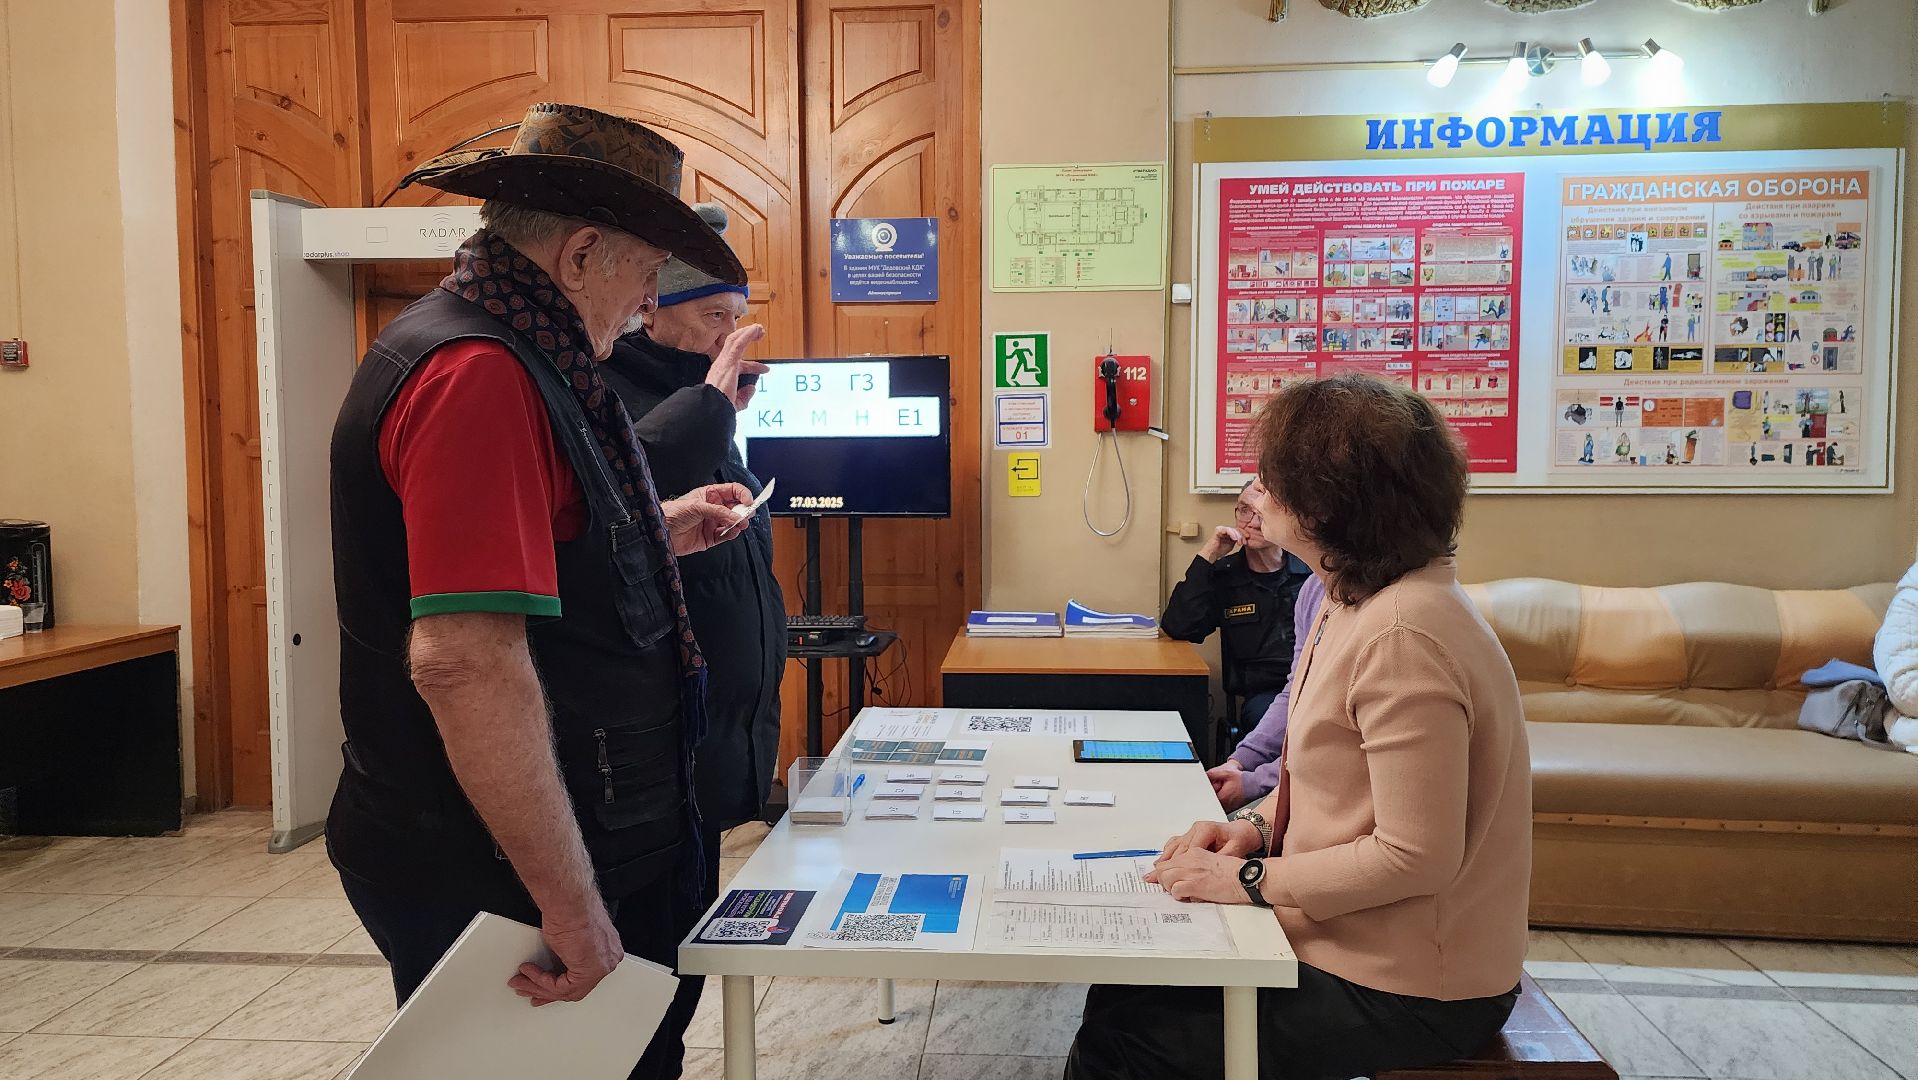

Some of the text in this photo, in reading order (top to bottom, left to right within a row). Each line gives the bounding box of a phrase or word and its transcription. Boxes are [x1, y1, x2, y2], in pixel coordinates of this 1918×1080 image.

[1366, 111, 1722, 151] ИНФОРМАЦИЯ
[1249, 179, 1505, 195] УМЕЙ ДЕЙСТВОВАТЬ ПРИ ПОЖАРЕ
[1568, 176, 1862, 201] ГРАЖДАНСКАЯ ОБОРОНА
[419, 228, 466, 238] RADAR
[1123, 366, 1147, 380] 112
[795, 374, 822, 392] В3
[850, 373, 874, 392] Г3
[758, 408, 923, 428] К4 М Н Е1
[789, 496, 844, 509] 27.03.2025
